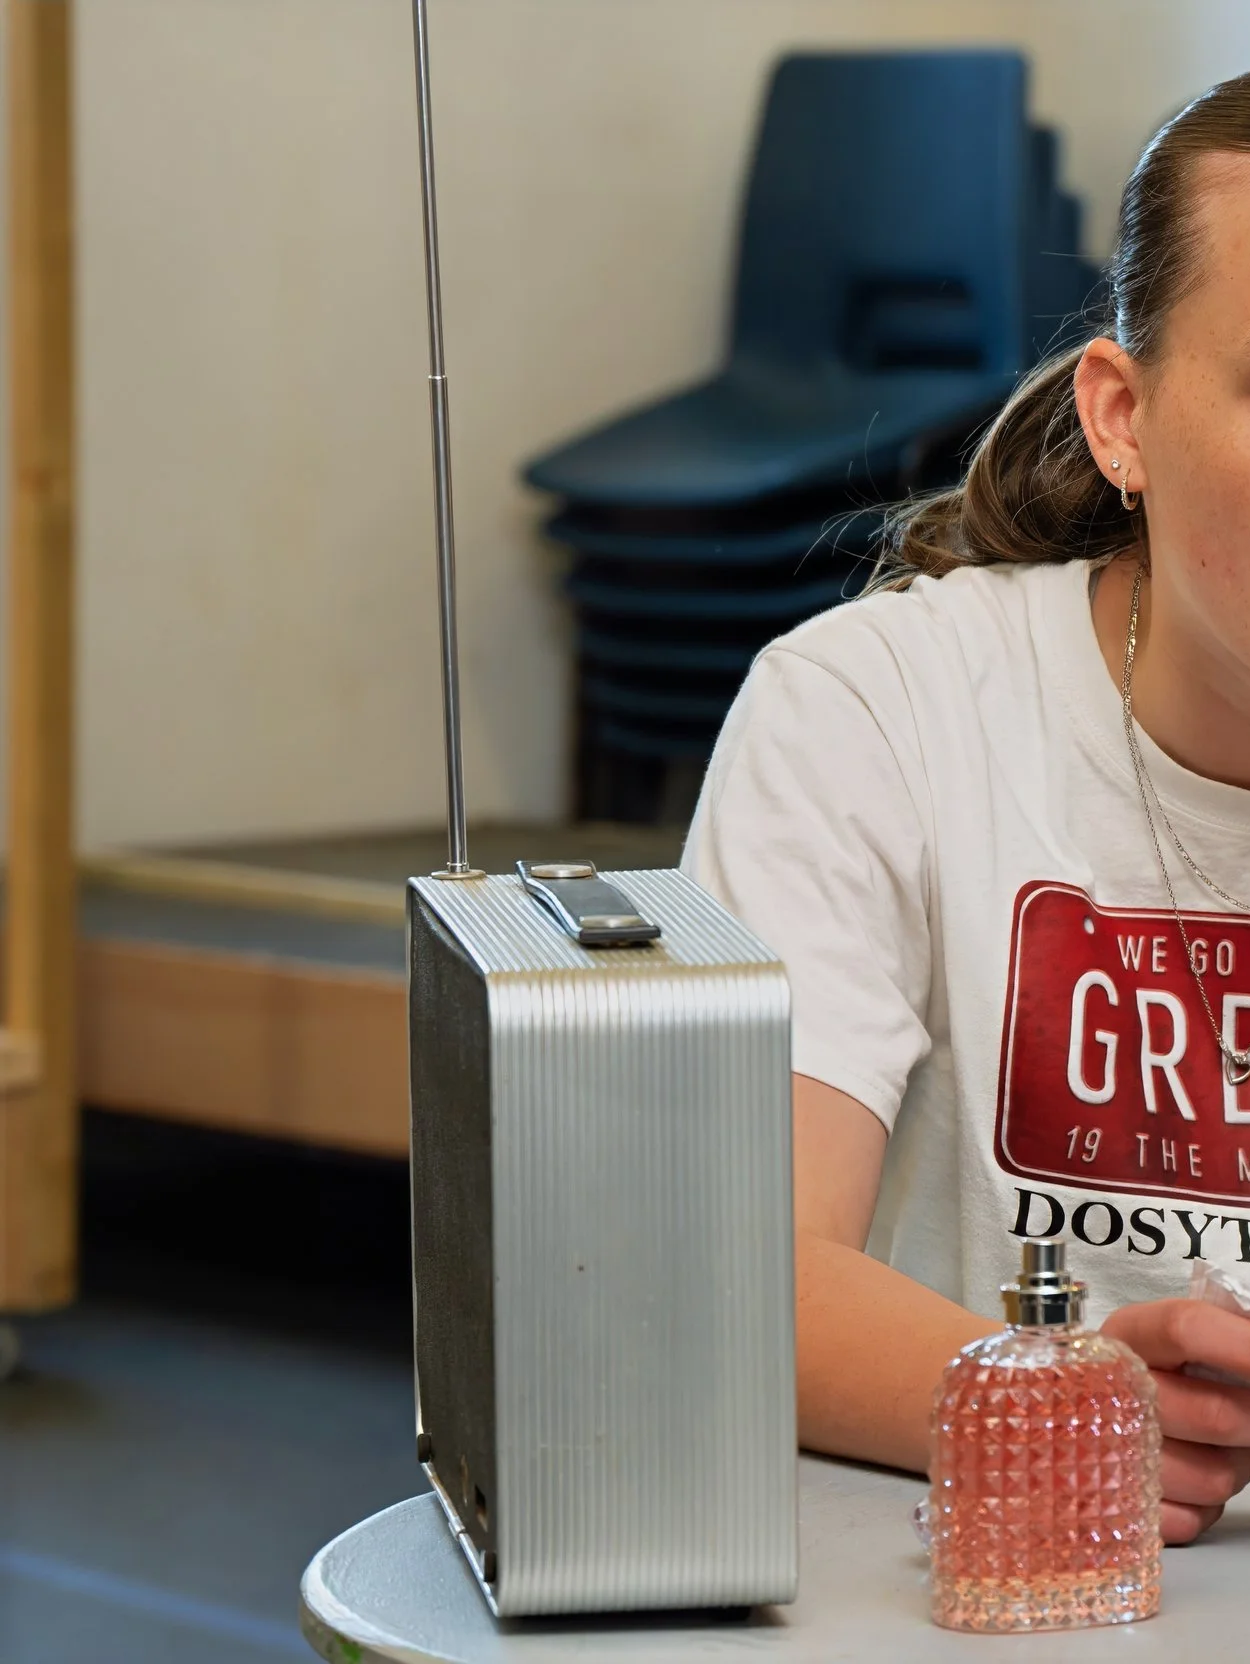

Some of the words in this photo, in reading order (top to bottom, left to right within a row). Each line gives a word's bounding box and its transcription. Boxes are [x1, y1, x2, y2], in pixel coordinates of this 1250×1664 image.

[1117, 934, 1169, 974] WE
[1190, 938, 1235, 976] GO
[1065, 1125, 1102, 1163] 19
[1135, 1133, 1202, 1177] THE
